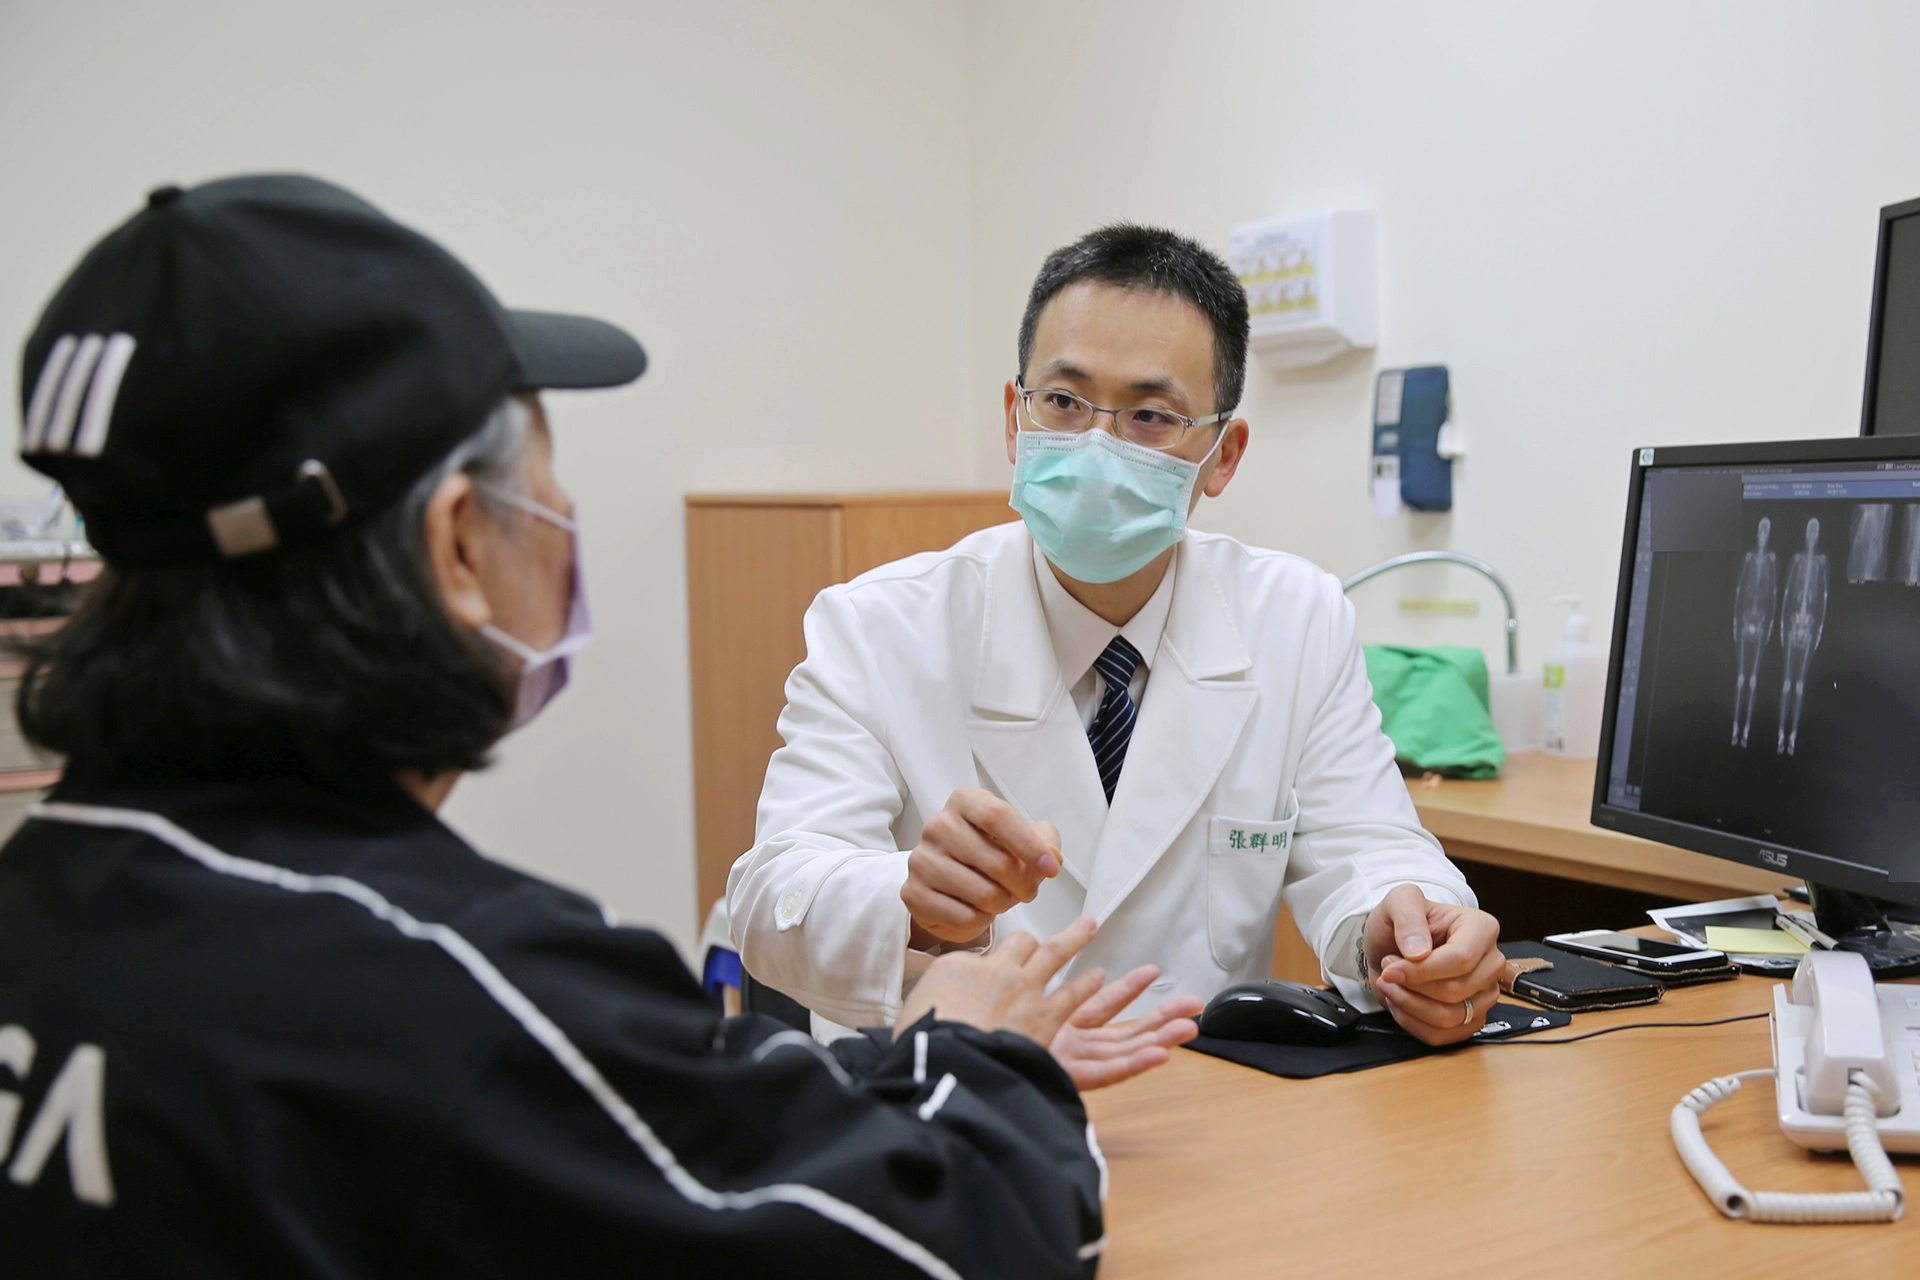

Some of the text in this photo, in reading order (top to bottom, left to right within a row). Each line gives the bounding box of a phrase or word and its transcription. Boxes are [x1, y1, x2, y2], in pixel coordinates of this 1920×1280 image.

[1229, 829, 1288, 853] 張群明
[1757, 848, 1788, 867] ASUS
